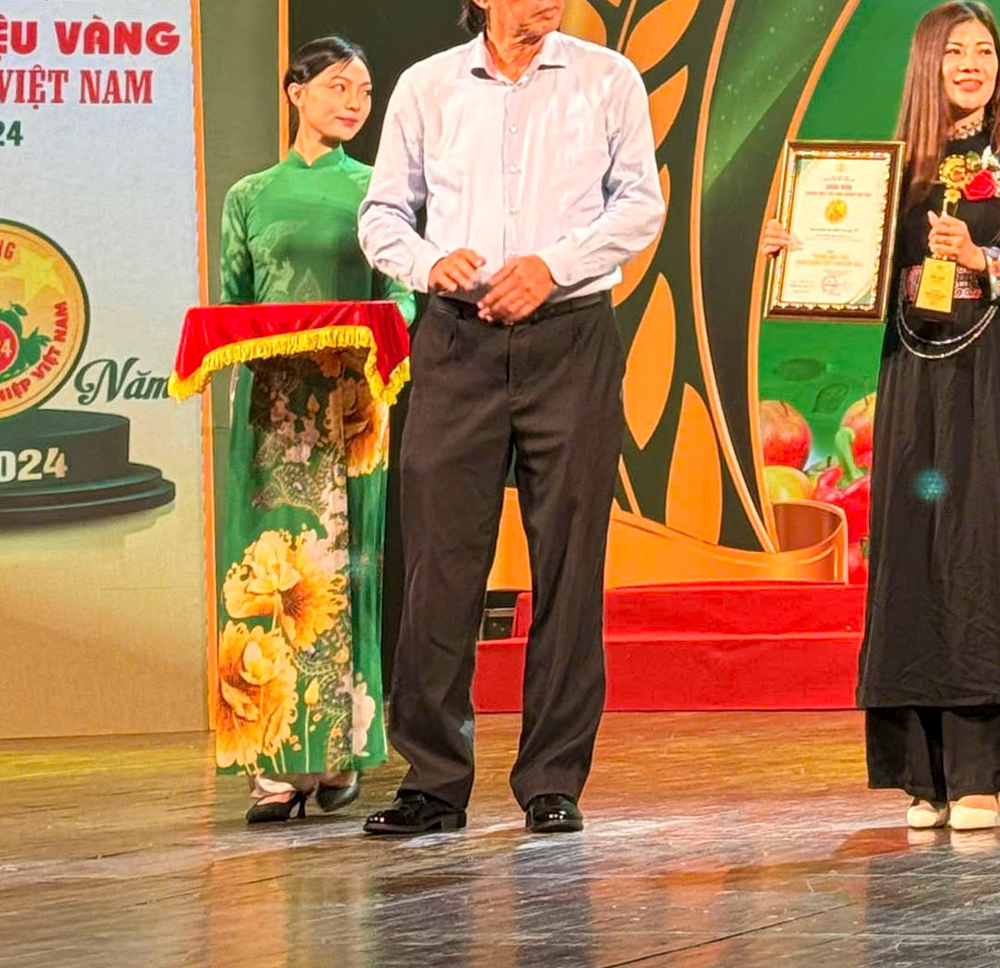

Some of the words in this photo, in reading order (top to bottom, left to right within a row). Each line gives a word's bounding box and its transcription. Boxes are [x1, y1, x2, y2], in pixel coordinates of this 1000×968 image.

[54, 14, 181, 56] VÀNG
[0, 64, 69, 110] VIỆT
[79, 69, 154, 104] NAM
[53, 300, 70, 343] NAM
[73, 356, 170, 406] Năm
